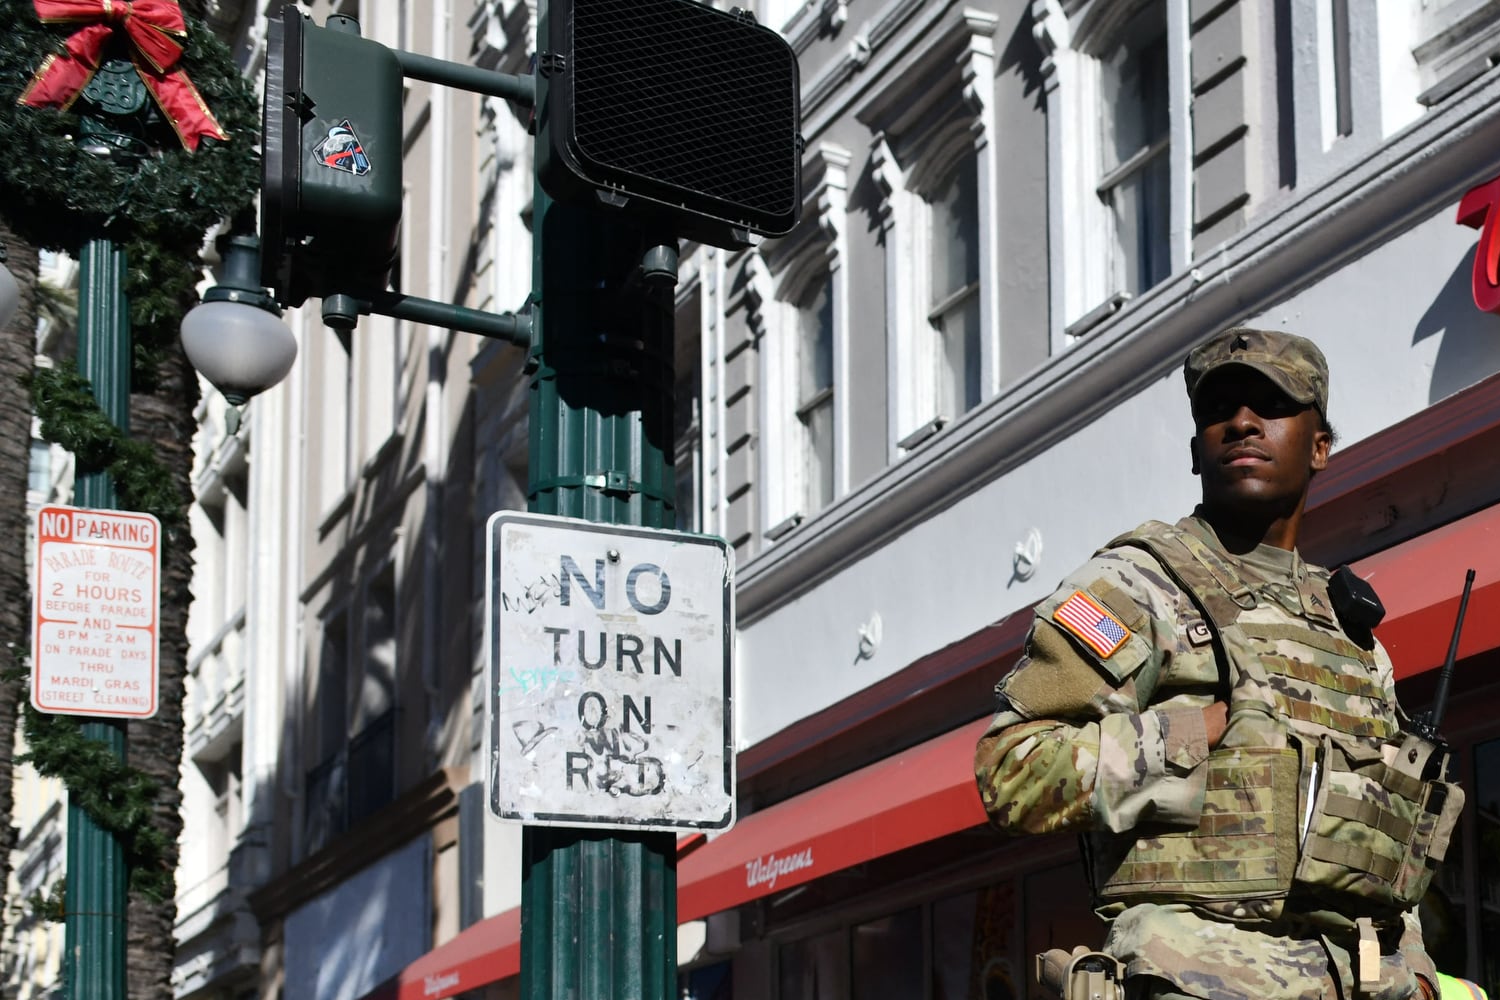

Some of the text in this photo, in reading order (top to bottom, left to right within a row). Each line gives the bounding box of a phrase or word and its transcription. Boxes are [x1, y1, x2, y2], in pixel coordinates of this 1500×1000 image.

[42, 512, 149, 543] NO PARKING
[45, 549, 96, 572] PARADE
[85, 571, 110, 582] FOR
[560, 554, 672, 616] NO
[52, 582, 141, 603] 2 HOURS
[46, 600, 147, 618] BEFORE PARADE
[83, 618, 112, 630] AND
[45, 643, 147, 660] ON PARADE DAYS
[544, 626, 682, 676] TURN
[80, 661, 114, 673] THRU
[51, 675, 140, 690] MARDI GRAS
[578, 691, 652, 735] ON
[745, 846, 814, 889] Walgreens
